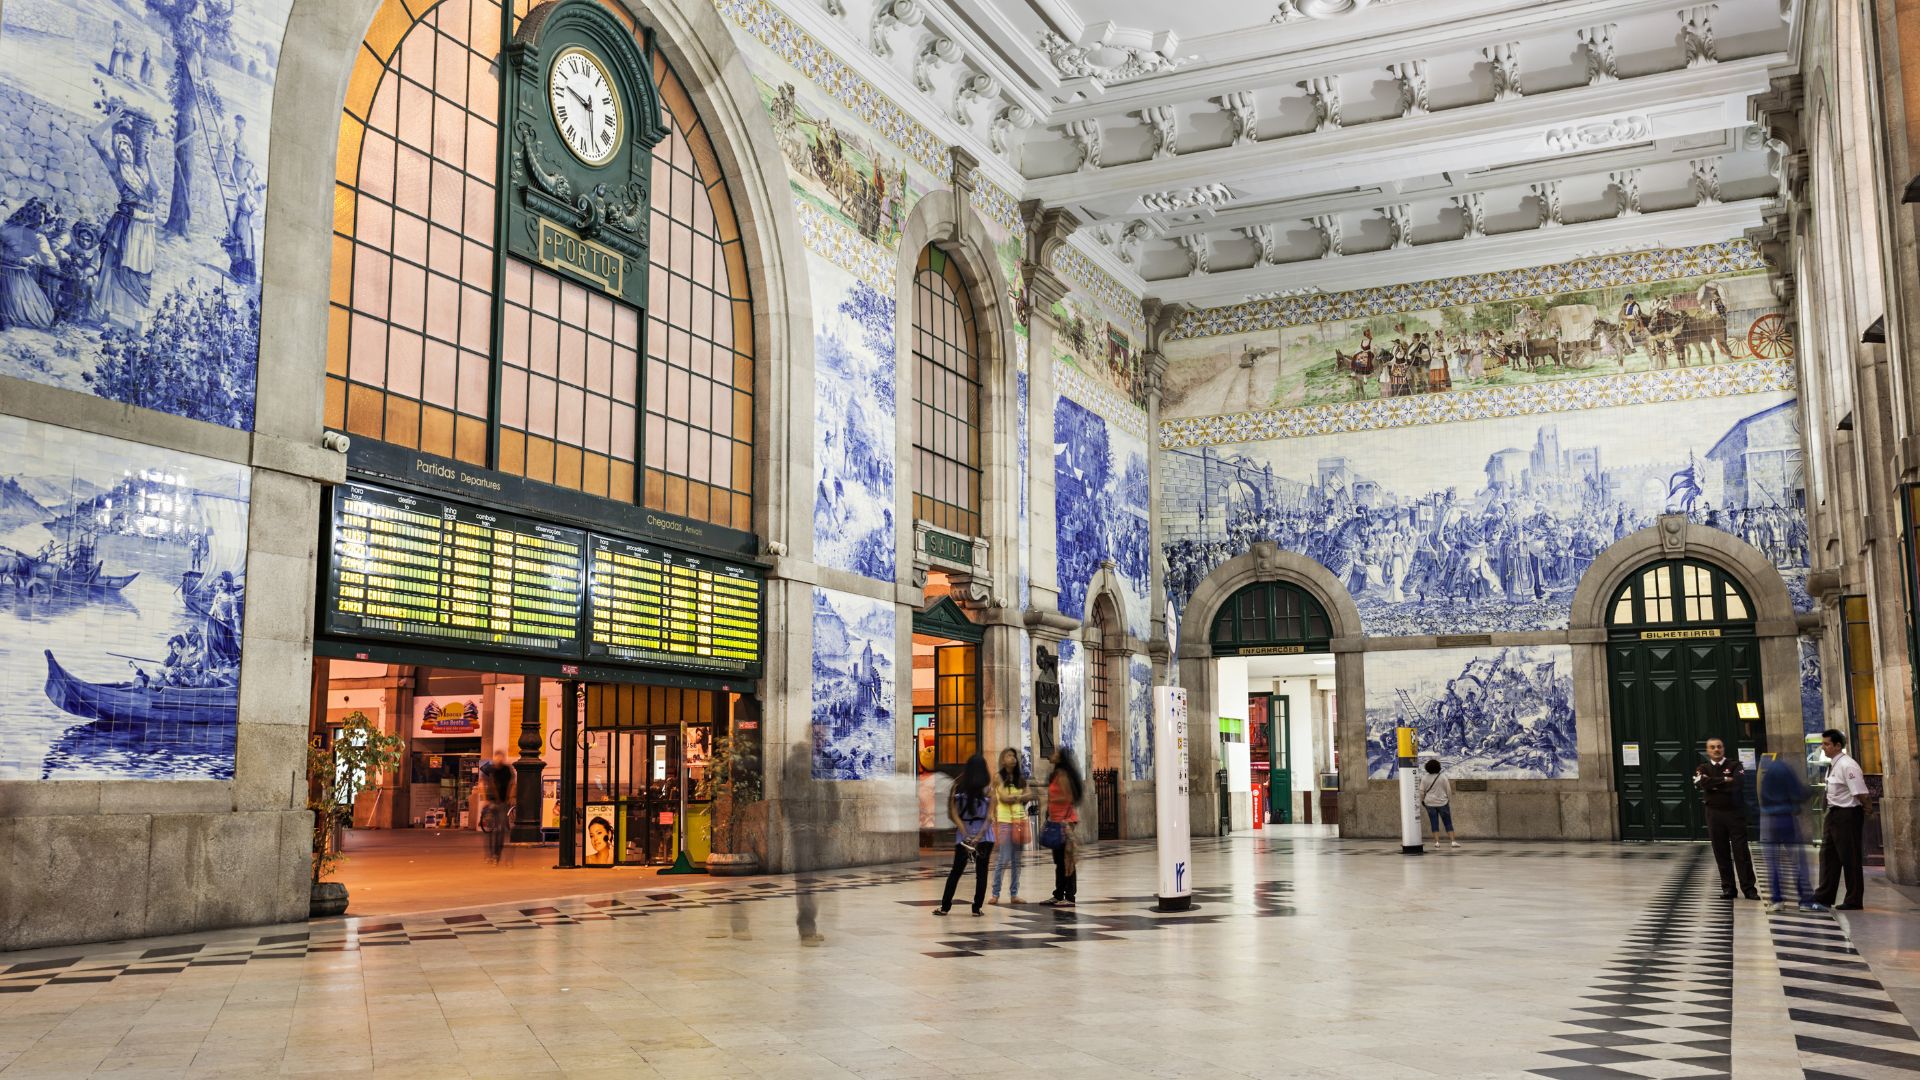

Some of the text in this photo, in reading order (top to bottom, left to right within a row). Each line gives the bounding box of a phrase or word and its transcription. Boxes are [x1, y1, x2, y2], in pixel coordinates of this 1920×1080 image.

[554, 232, 610, 277] PORTO
[416, 460, 501, 491] Partidas Departures
[398, 497, 416, 506] destino
[444, 506, 457, 515] linha
[476, 514, 496, 522] comboio
[647, 515, 682, 531] Chegadas
[931, 536, 965, 560] SAIDA
[340, 571, 364, 584] 22H55
[339, 600, 363, 612] 23H20
[367, 604, 407, 618] GUIMARAES
[452, 602, 476, 613] SUBURB
